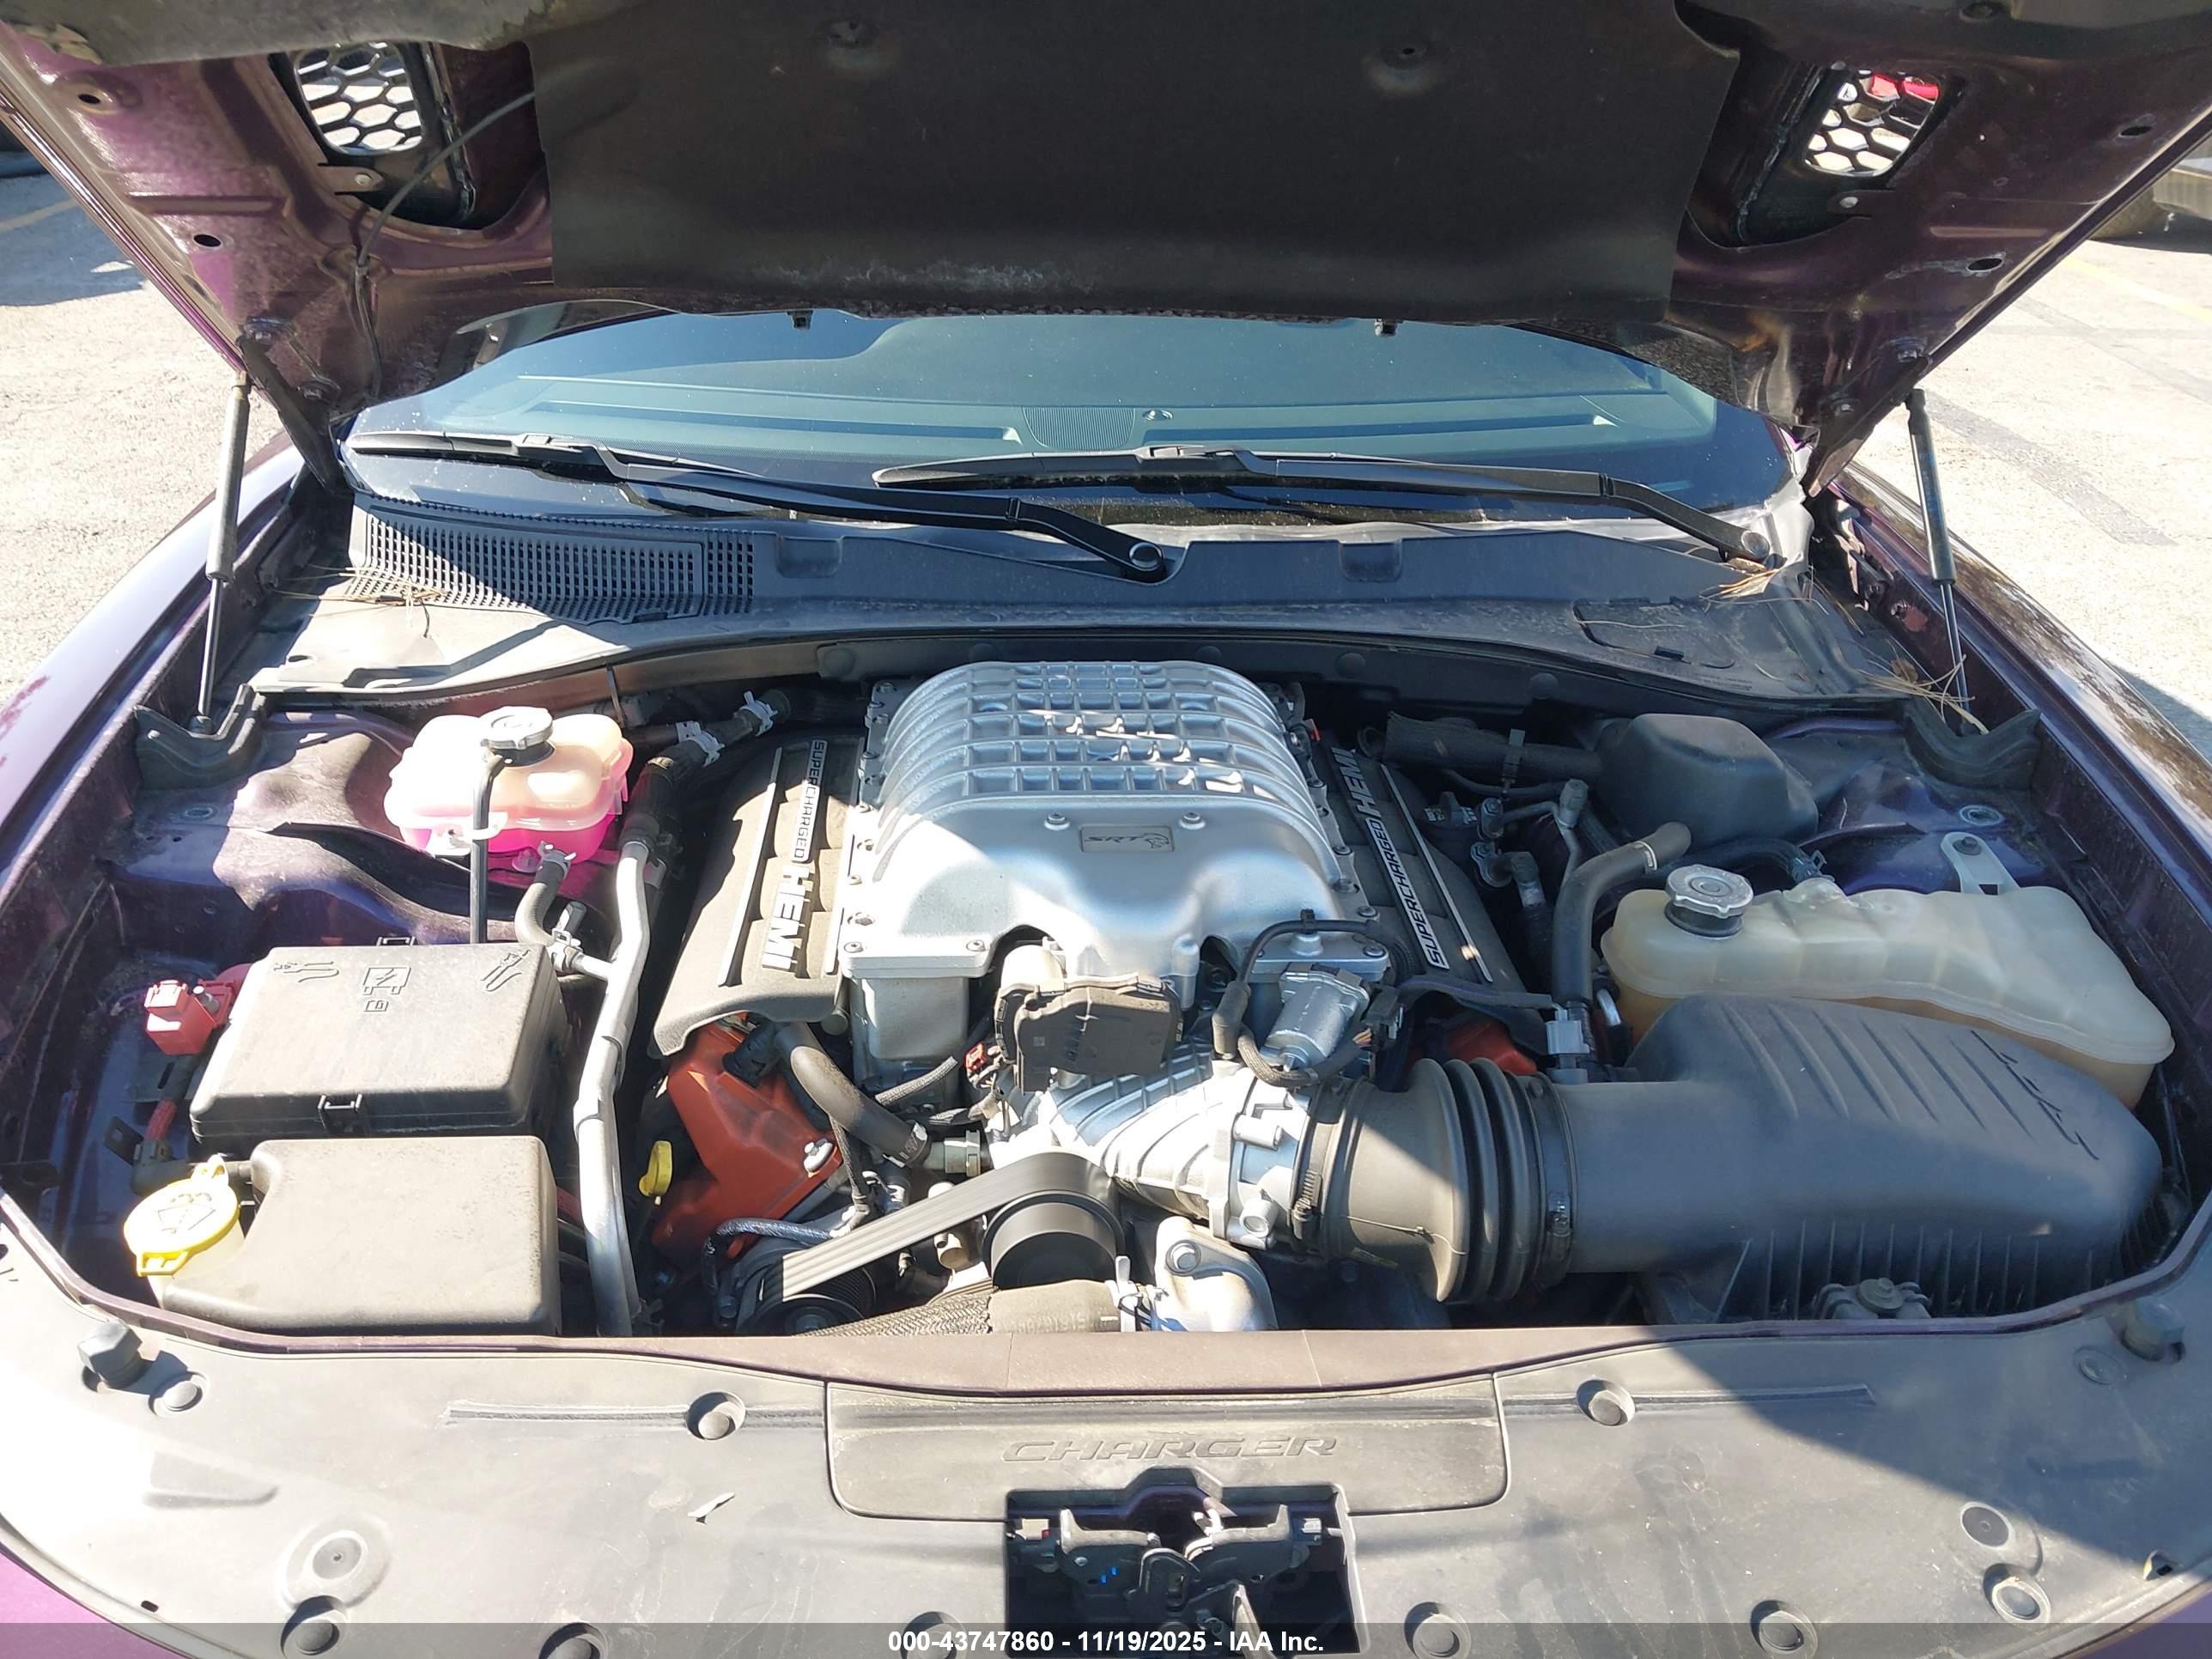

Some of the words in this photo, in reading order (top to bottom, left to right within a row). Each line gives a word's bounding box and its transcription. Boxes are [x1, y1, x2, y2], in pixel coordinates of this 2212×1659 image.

[793, 739, 825, 860] SUPERCHARGED
[1333, 748, 1382, 818] HEMI
[762, 864, 813, 972] HEMI
[1367, 818, 1445, 967] SUPERCHARGED
[1002, 1436, 1337, 1462] CHARGER
